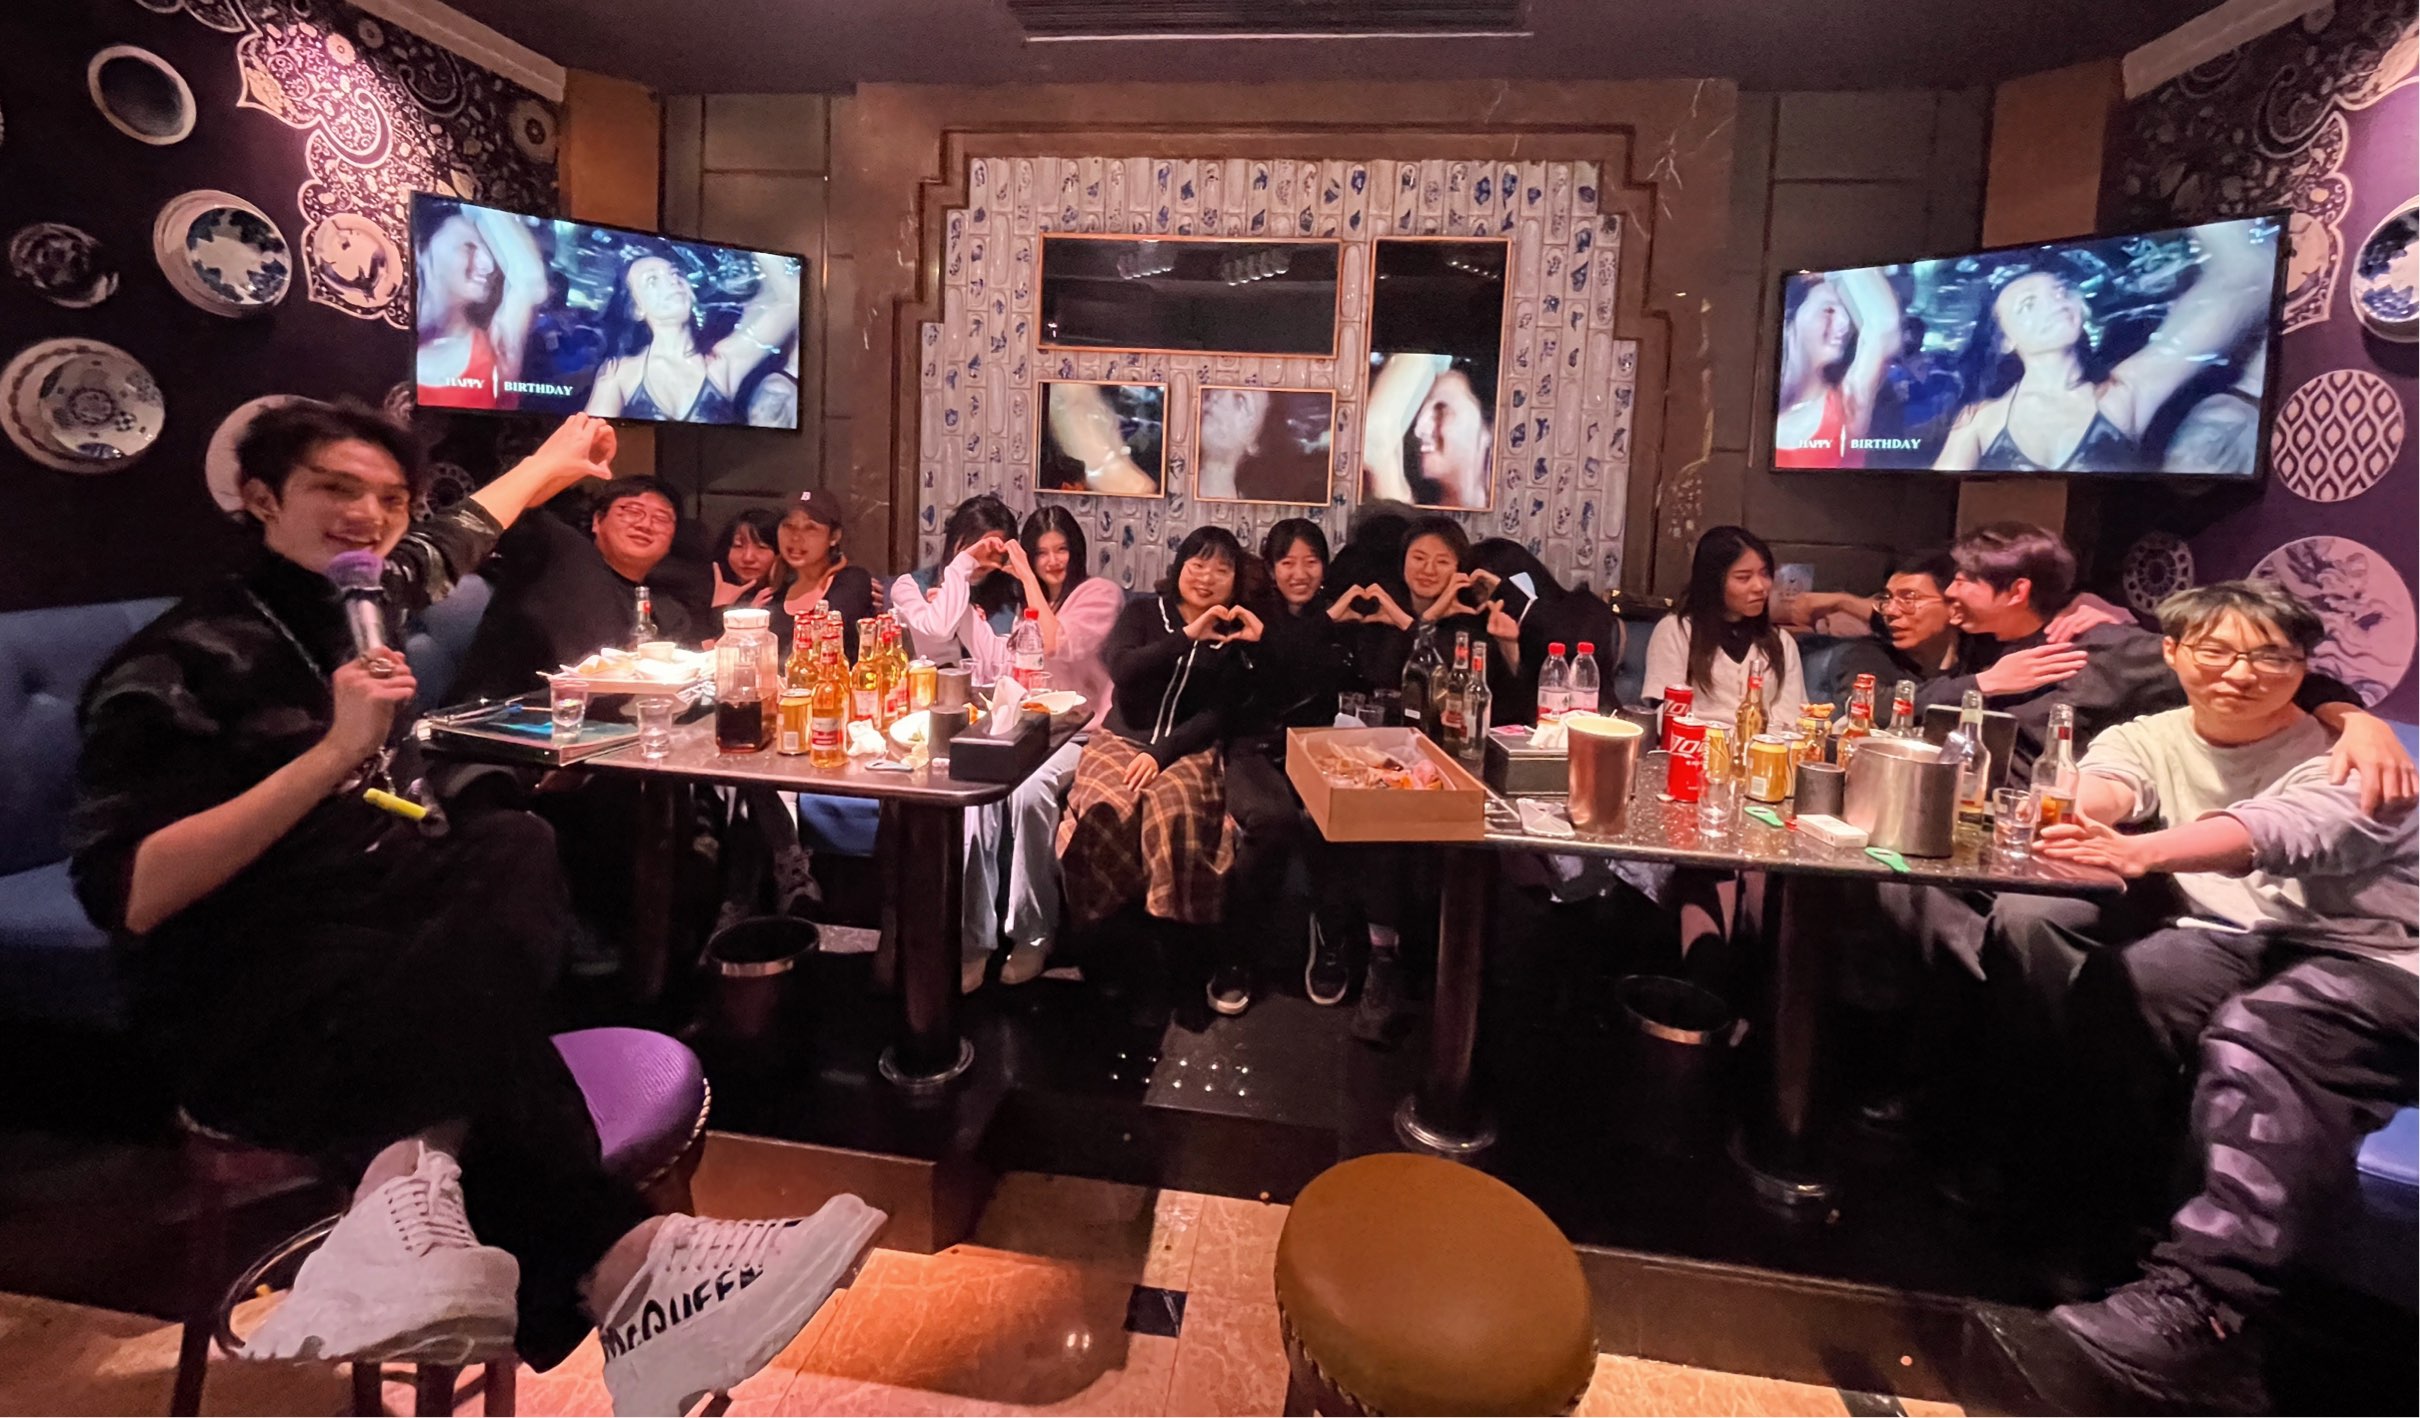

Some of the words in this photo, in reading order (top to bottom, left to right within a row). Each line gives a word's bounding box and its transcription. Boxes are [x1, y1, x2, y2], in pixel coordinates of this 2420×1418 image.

[445, 377, 485, 389] HAPPY
[503, 381, 573, 396] BIRTHDAY
[1798, 439, 1833, 449] HAPPY
[1850, 438, 1921, 449] BIRTHDAY
